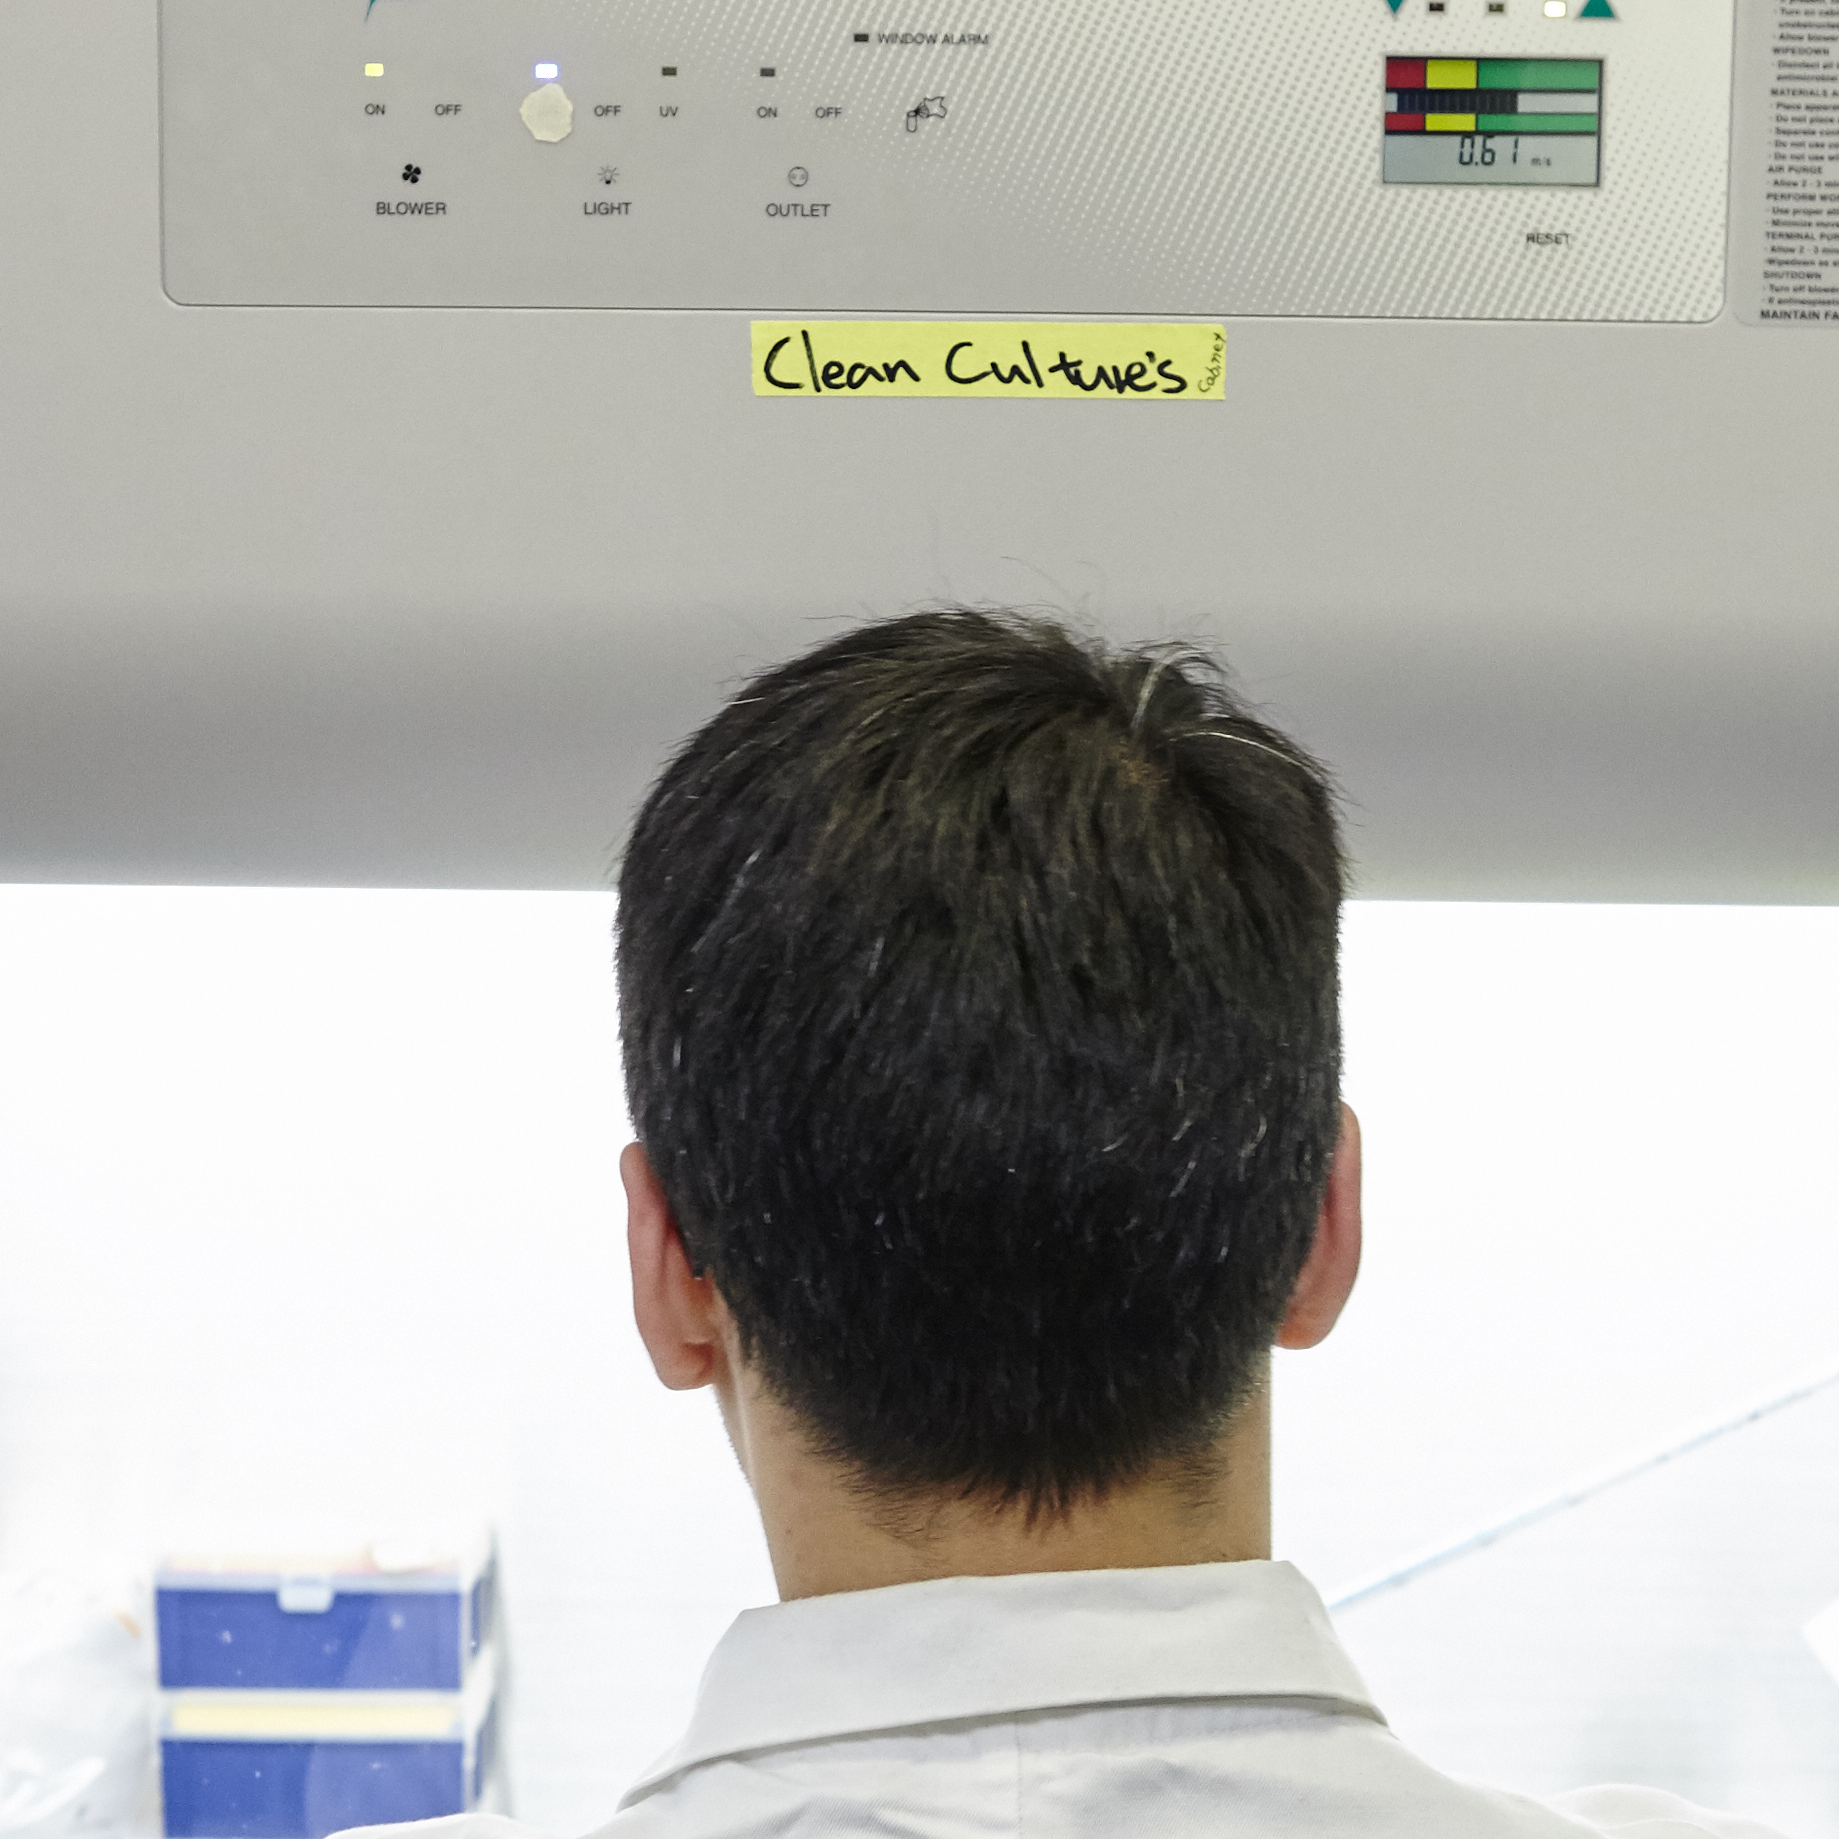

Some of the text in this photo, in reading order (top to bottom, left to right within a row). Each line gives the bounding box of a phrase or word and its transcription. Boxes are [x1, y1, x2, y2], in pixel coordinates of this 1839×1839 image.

[878, 32, 989, 46] WINDOW ALARM
[365, 104, 462, 116] ON OFF
[594, 105, 679, 117] OFF UV
[757, 106, 843, 119] ON OFF
[1459, 136, 1519, 166] 0.61
[375, 202, 447, 216] BLOWER
[584, 202, 631, 216] LIGHT
[766, 203, 830, 217] OUTLET
[1526, 233, 1570, 244] RESET
[1761, 310, 1820, 321] MAINTAIN
[764, 329, 1188, 394] Clean Culture's
